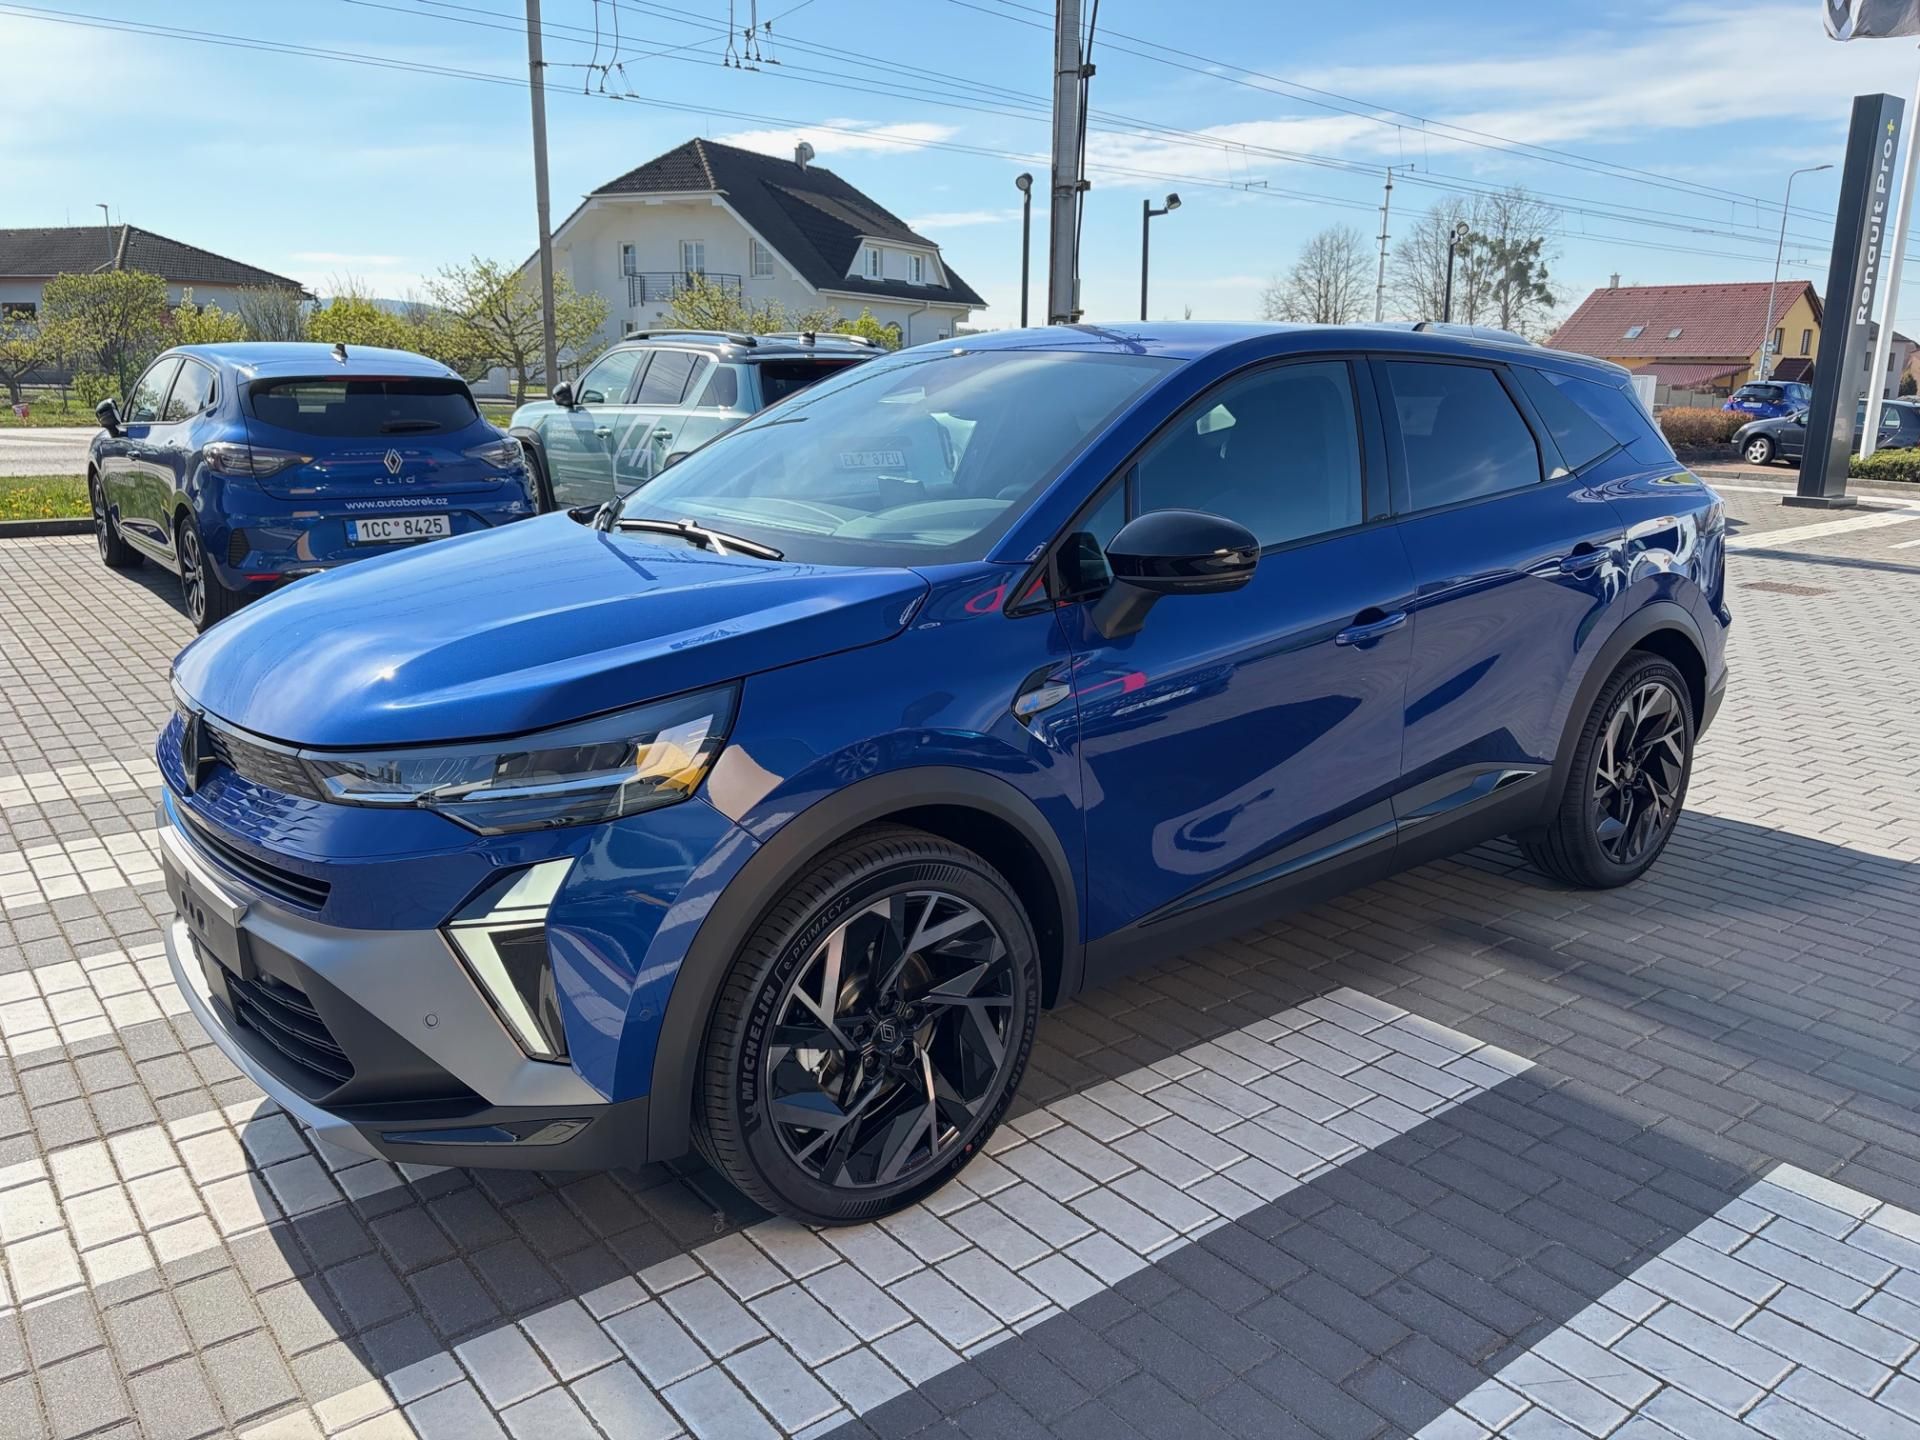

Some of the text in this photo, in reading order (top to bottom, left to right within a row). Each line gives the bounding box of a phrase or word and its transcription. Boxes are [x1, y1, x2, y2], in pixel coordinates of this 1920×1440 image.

[1855, 200, 1885, 326] Renault
[361, 517, 443, 539] 1CC 8425
[742, 984, 777, 1101] MICHELIN
